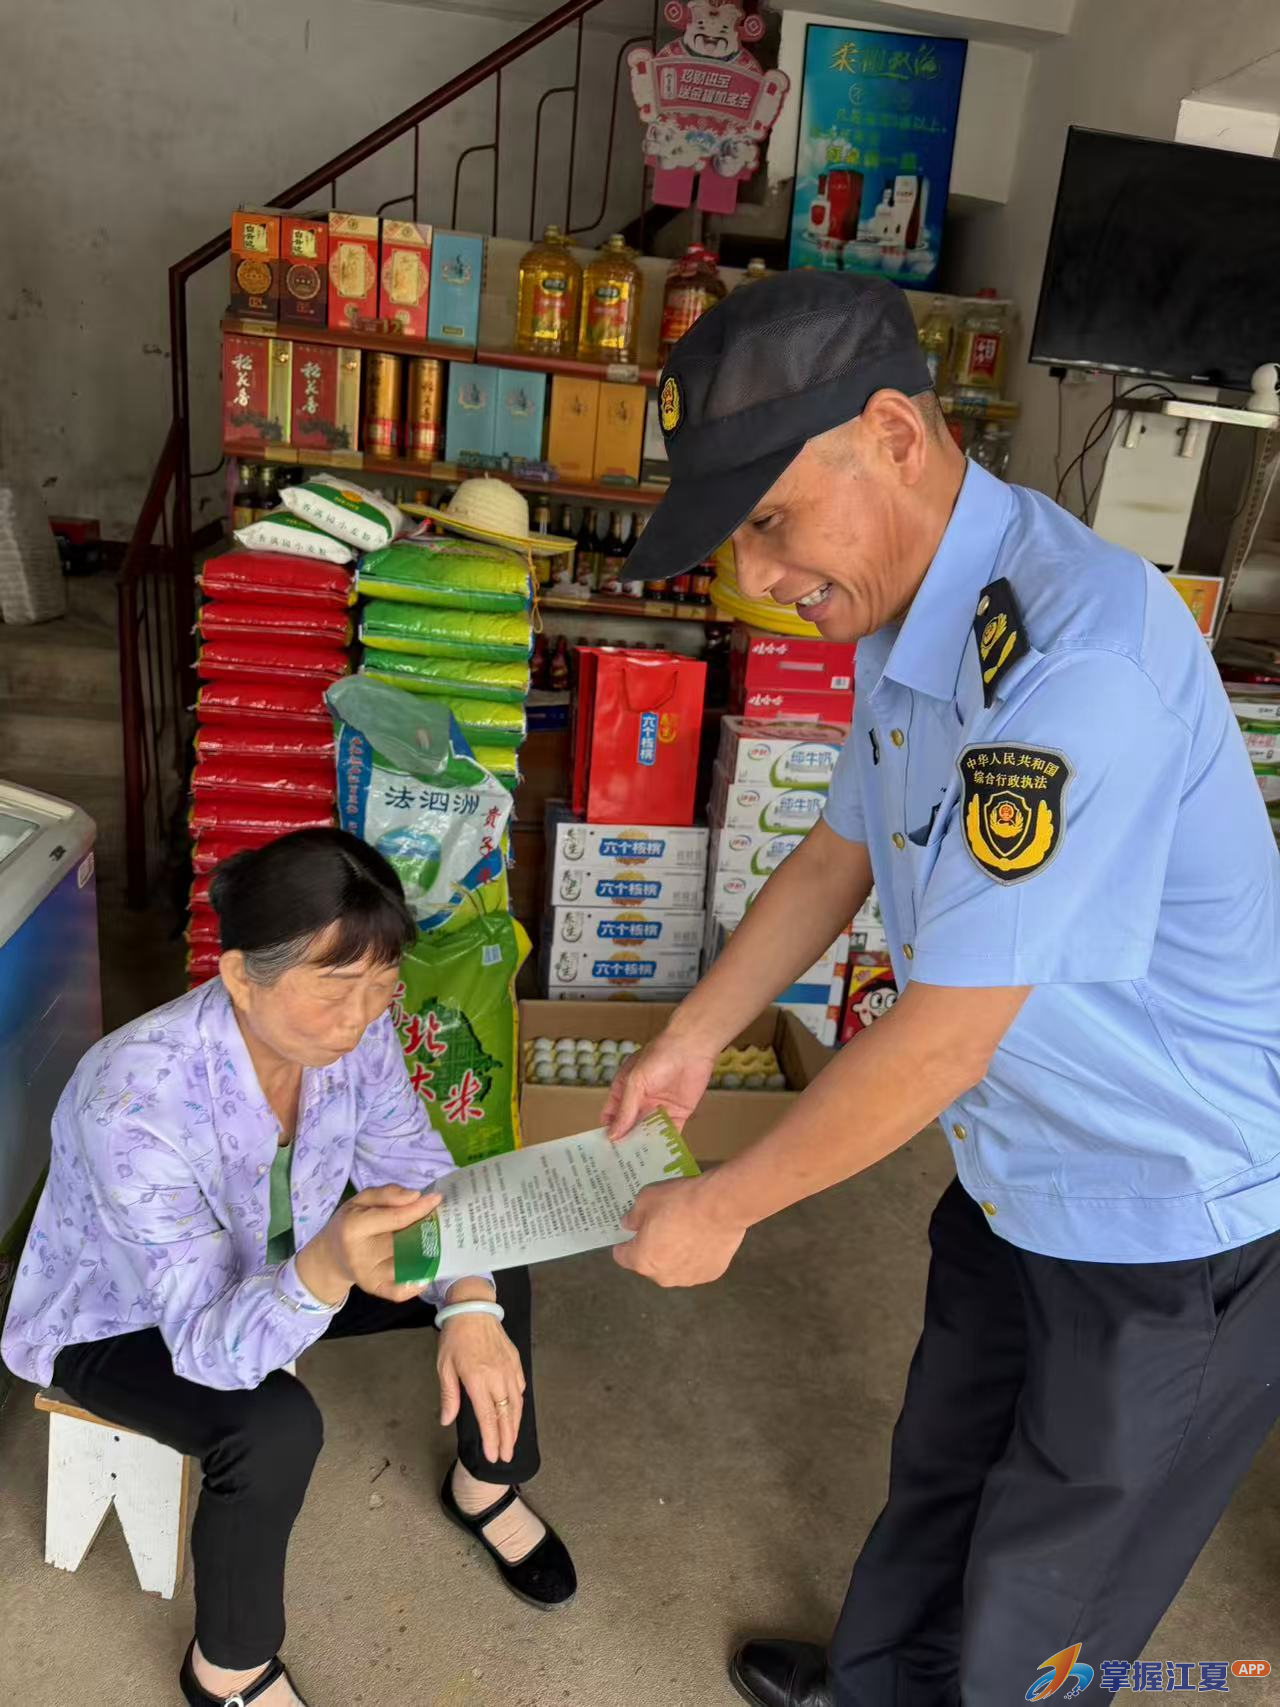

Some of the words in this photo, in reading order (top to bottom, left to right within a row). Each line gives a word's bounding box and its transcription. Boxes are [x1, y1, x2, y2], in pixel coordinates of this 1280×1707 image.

[966, 752, 1059, 777] 中华人民共和国
[973, 769, 1048, 790] 综合行政执法
[384, 785, 480, 816] 法泗洲
[603, 841, 664, 855] 六个核桃
[599, 882, 660, 897] 六个核桃
[600, 923, 660, 937] 六个核桃
[595, 963, 655, 976] 六个核桃
